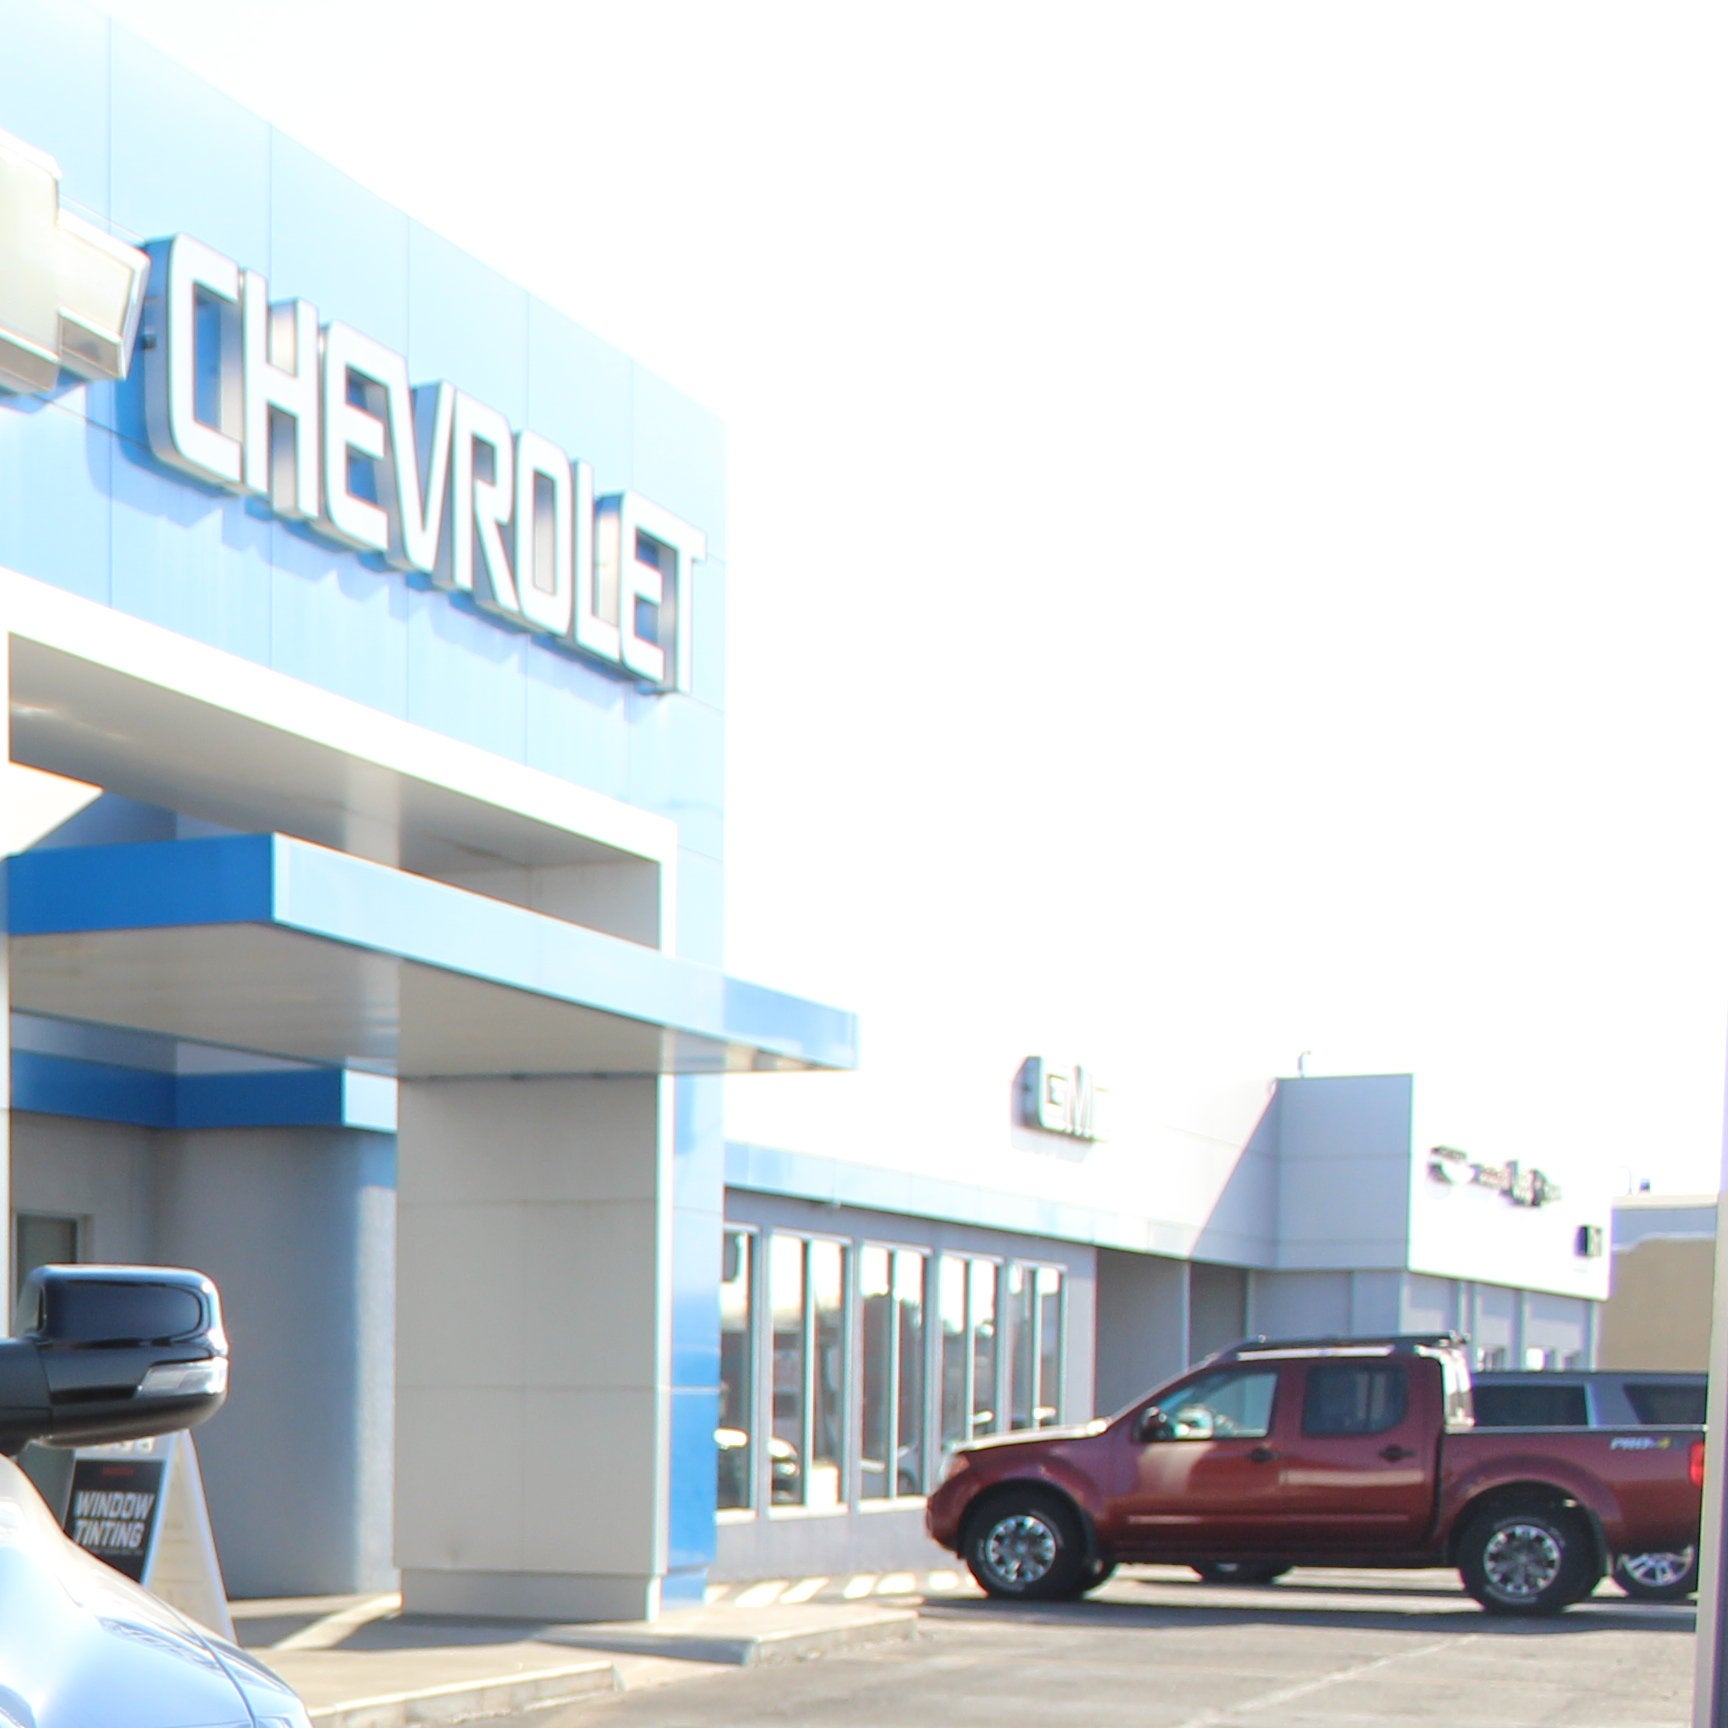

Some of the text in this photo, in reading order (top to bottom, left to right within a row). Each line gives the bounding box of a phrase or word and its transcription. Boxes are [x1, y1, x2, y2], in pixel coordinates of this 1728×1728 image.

[150, 232, 707, 695] CHEVROLET
[74, 1491, 155, 1519] WINDOW
[75, 1520, 144, 1548] TINTING
